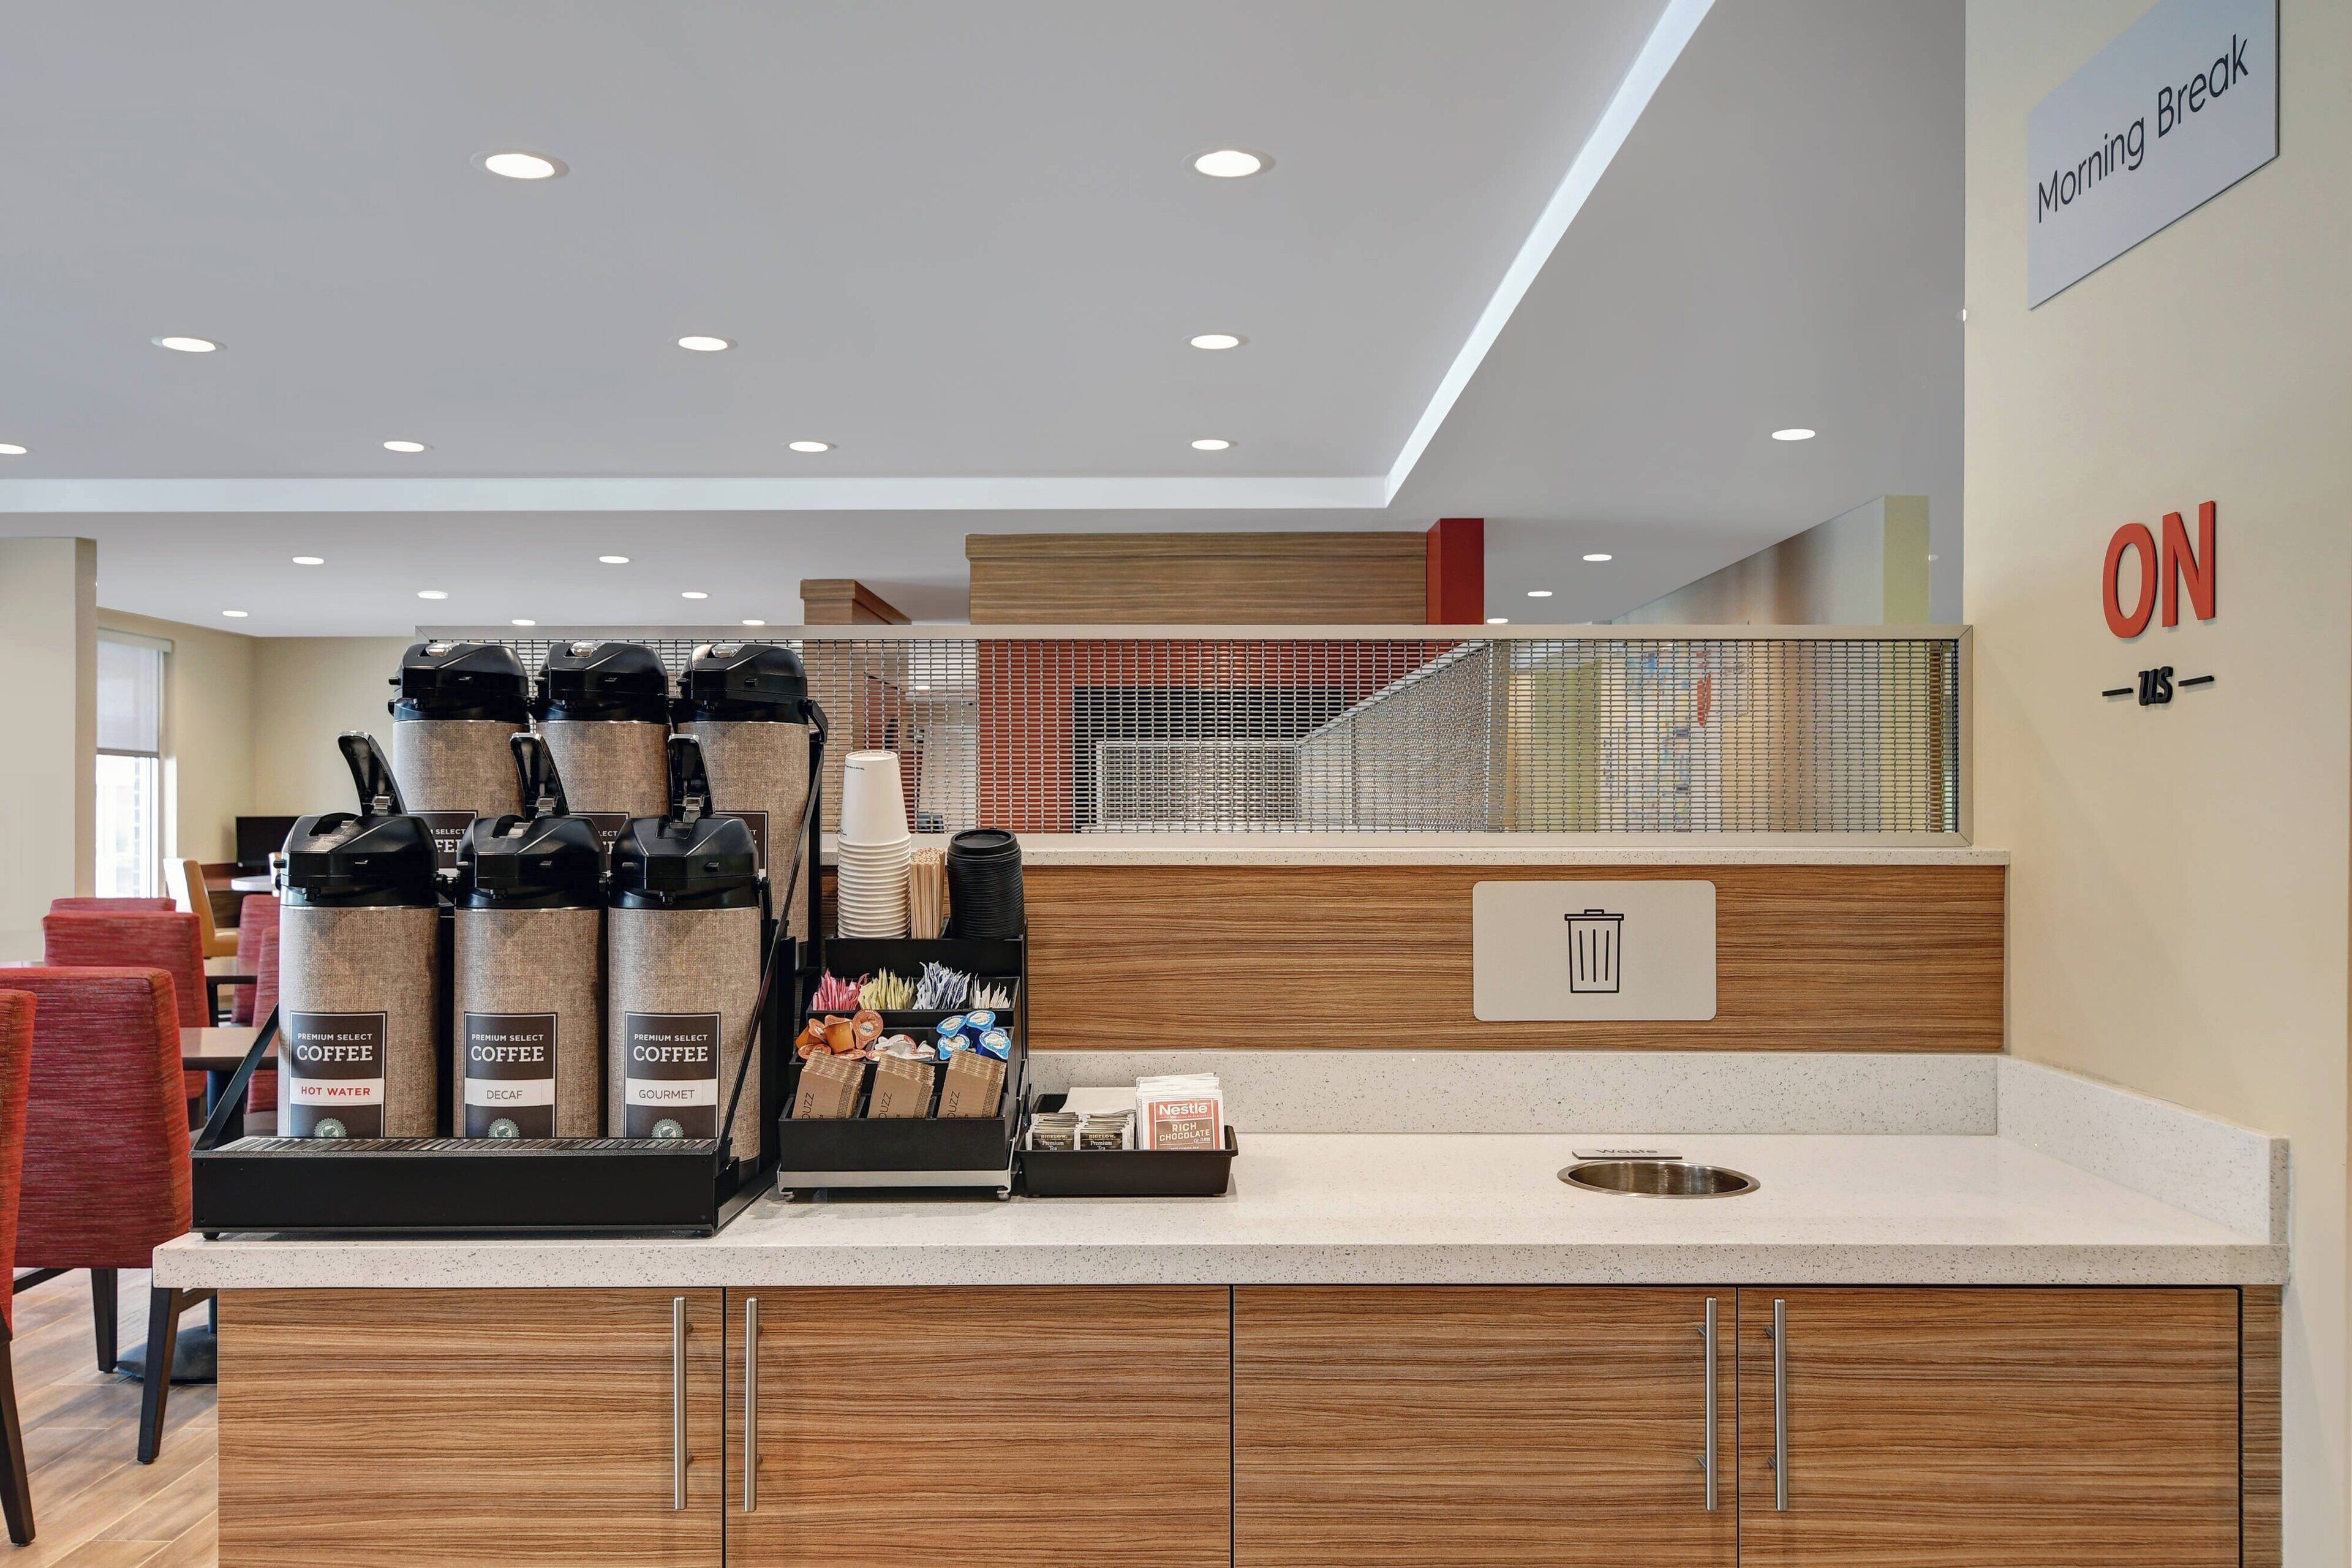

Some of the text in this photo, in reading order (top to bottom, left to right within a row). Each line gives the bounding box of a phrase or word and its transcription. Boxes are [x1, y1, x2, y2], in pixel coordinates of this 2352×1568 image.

[2038, 34, 2248, 224] Morning Break
[2102, 500, 2215, 638] ON
[2138, 666, 2174, 706] us
[296, 1044, 373, 1061] COFFEE
[471, 1046, 544, 1062] COFFEE
[633, 1046, 708, 1063] COFFEE
[301, 1087, 322, 1095] HOT
[486, 1090, 523, 1099] DECAF
[639, 1090, 695, 1099] GOURMET
[1159, 1129, 1210, 1141] CHOCOLATE
[1172, 1122, 1197, 1133] RICH
